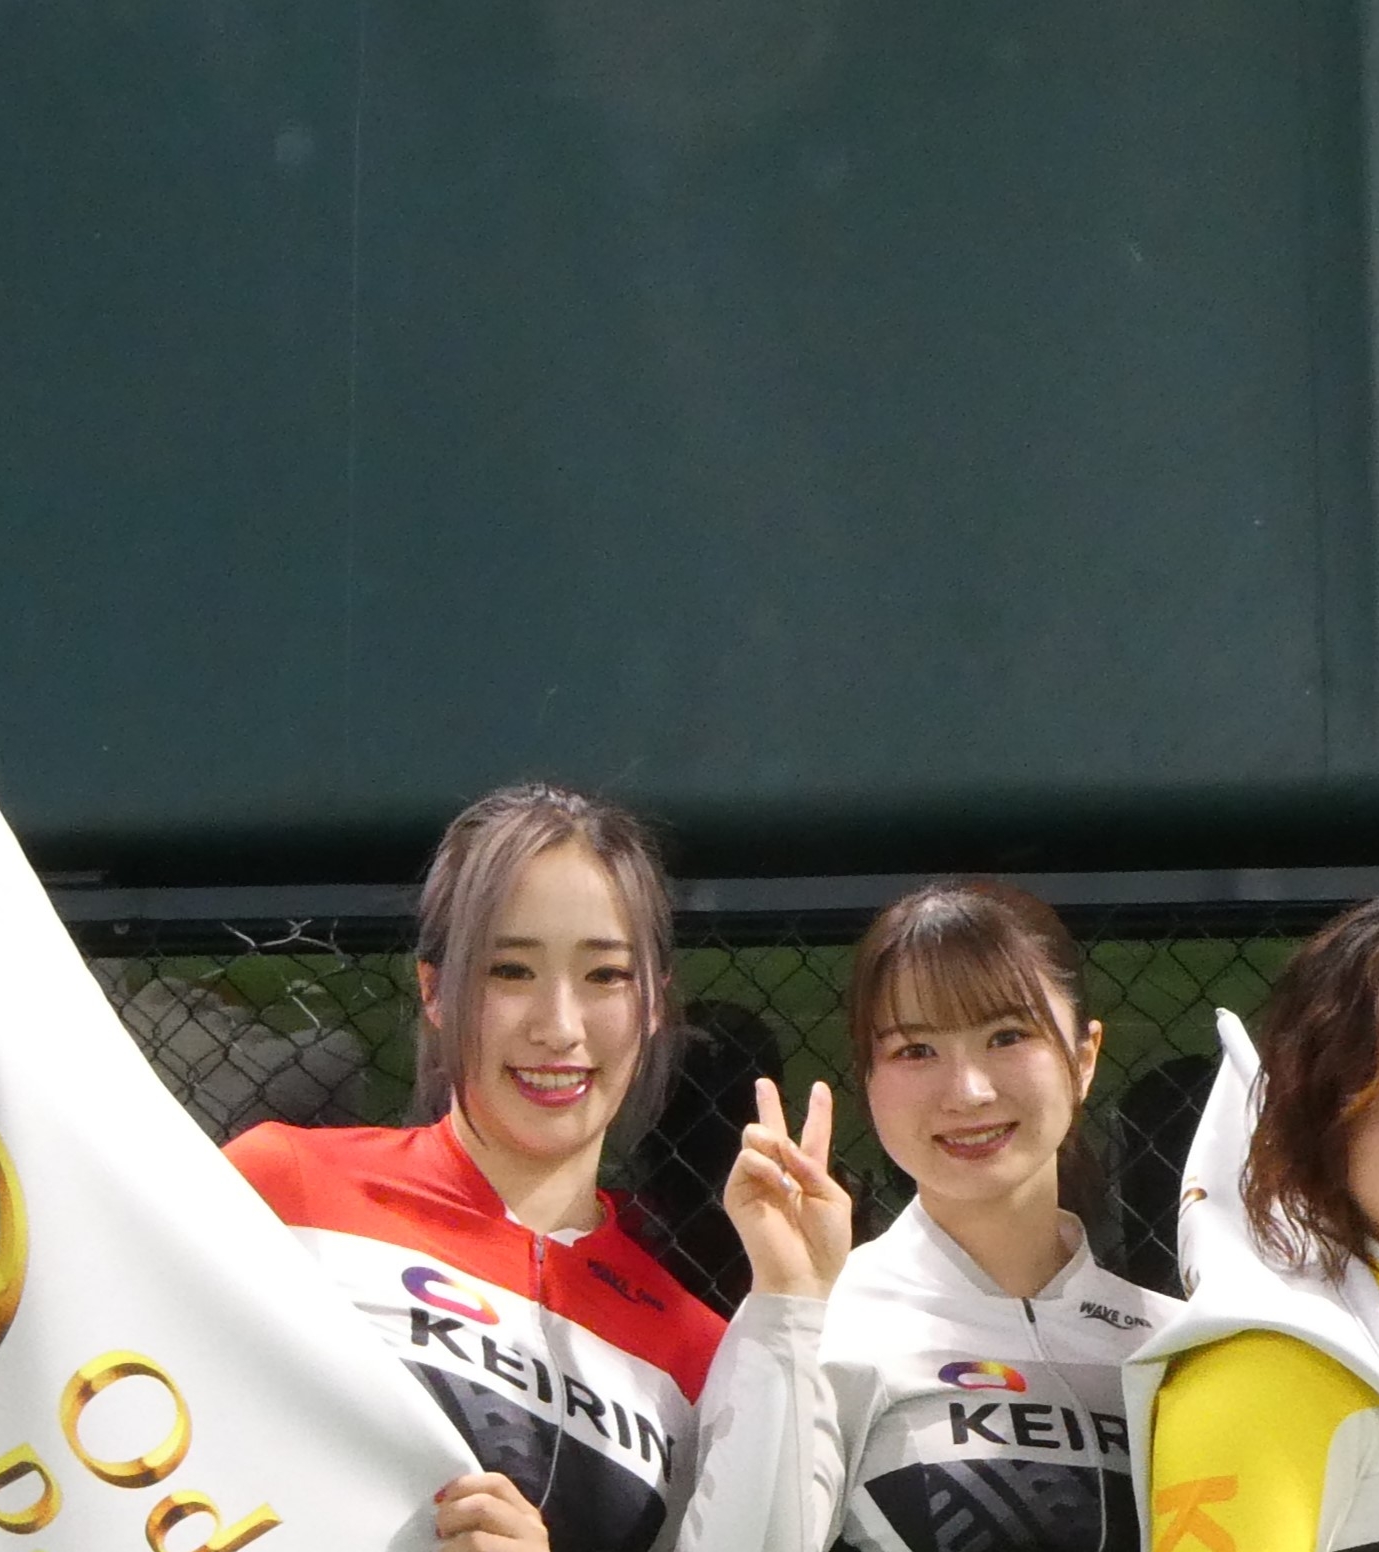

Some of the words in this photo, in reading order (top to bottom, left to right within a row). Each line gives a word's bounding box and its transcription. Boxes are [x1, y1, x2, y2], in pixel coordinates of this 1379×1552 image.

[1080, 1301, 1120, 1323] WAVE
[410, 1307, 675, 1484] KEIRIN
[949, 1402, 1131, 1456] KEIR
